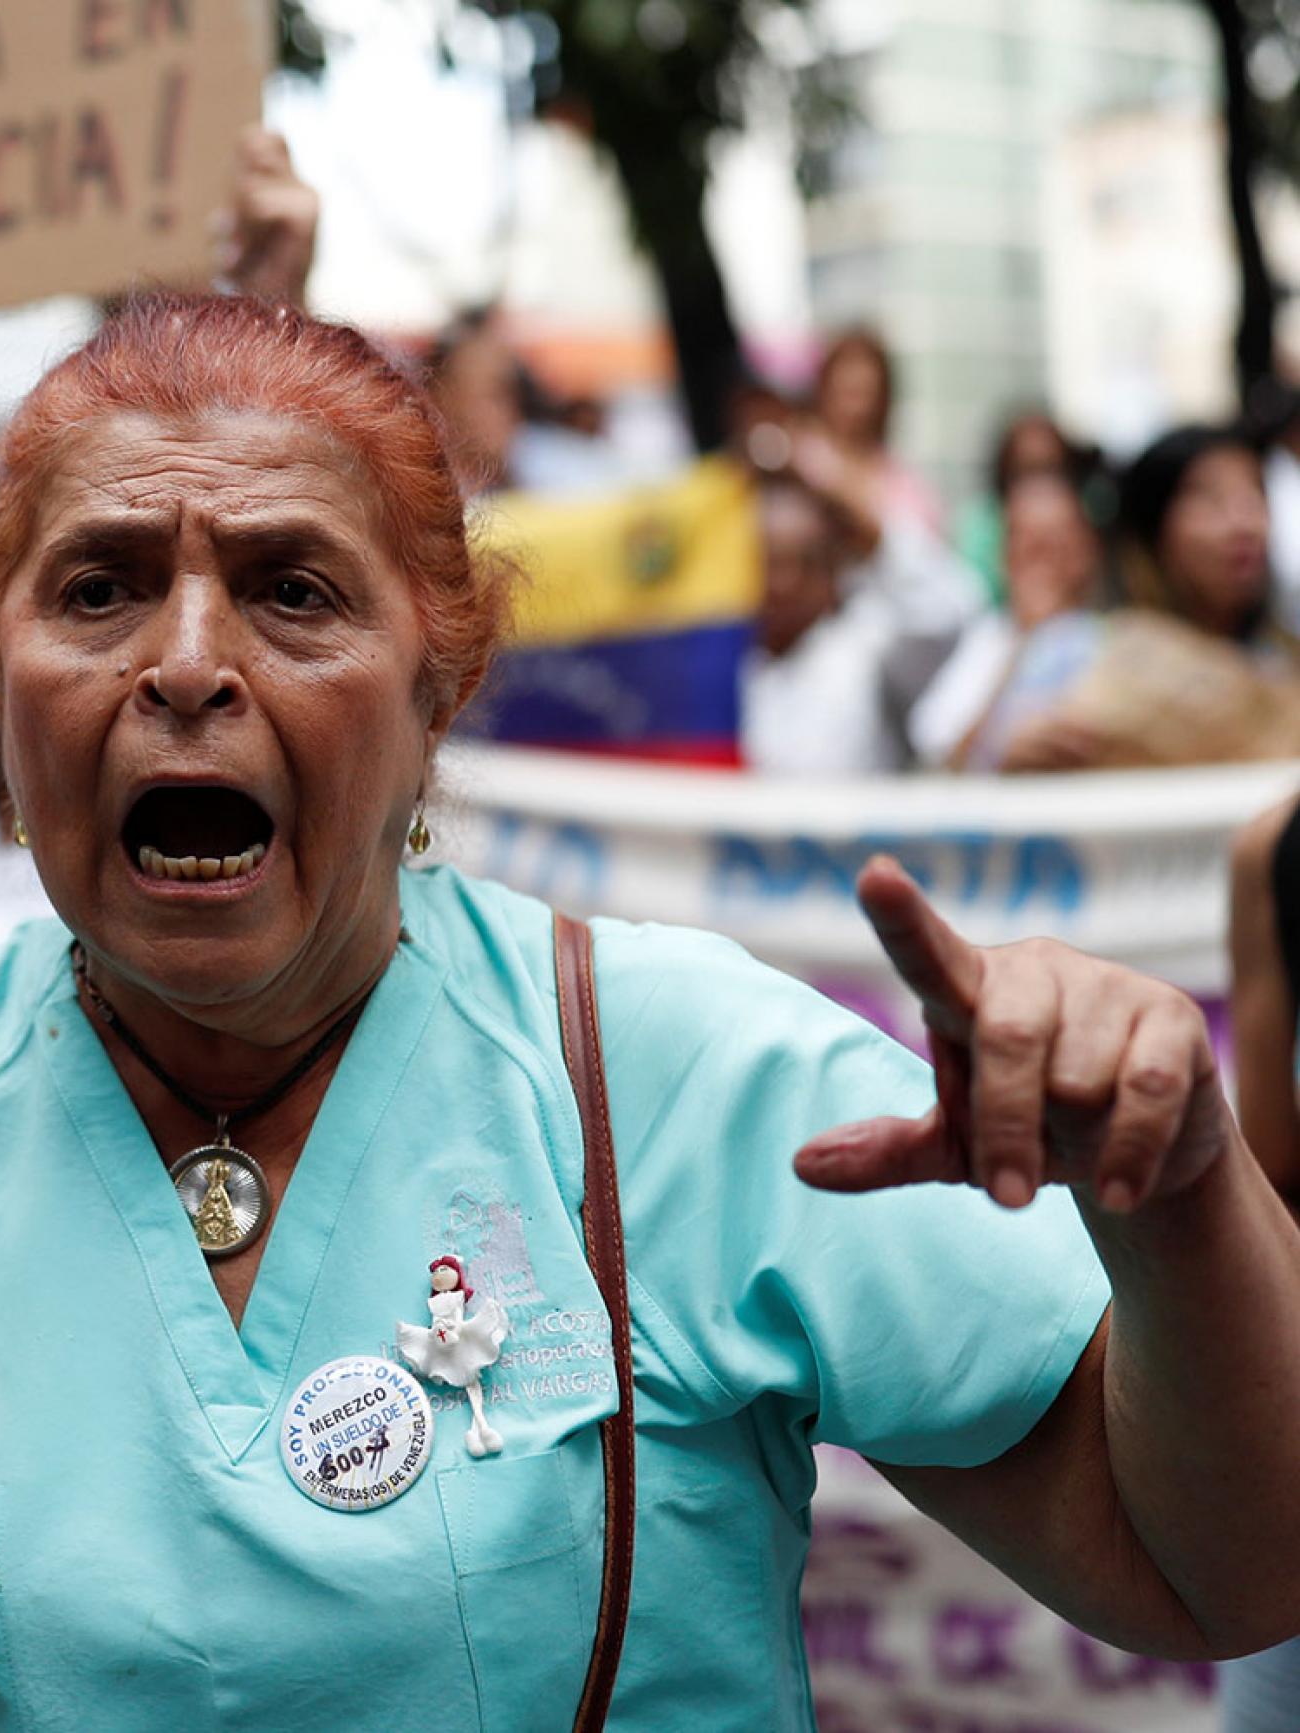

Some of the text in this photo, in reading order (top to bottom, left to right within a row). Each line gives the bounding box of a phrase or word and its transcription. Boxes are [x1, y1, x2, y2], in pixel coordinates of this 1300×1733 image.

[521, 1370, 614, 1401] VARGAS
[308, 1387, 387, 1436] MEREZCO
[312, 1402, 403, 1458] UN SUELDO DE
